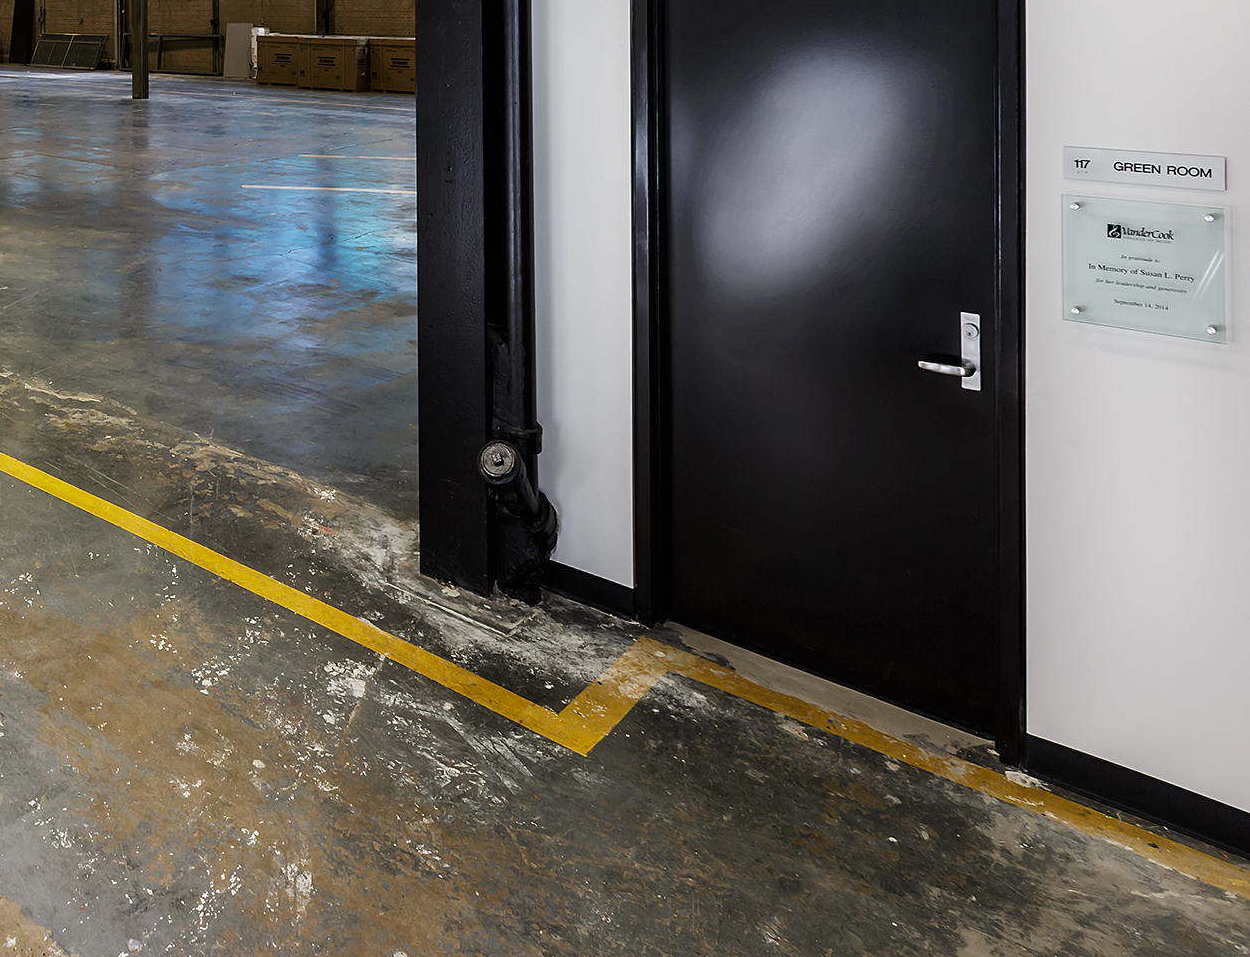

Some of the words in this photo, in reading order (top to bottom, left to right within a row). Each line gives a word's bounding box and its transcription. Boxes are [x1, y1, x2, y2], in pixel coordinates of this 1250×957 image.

[1073, 159, 1091, 169] 117
[1113, 161, 1161, 174] GREEN
[1166, 165, 1212, 178] ROOM
[1122, 226, 1174, 241] VanderCook
[1098, 264, 1128, 275] Memory
[1140, 269, 1162, 278] Susan
[1175, 274, 1195, 283] Perry
[1116, 280, 1145, 288] leadership
[1114, 299, 1143, 308] September
